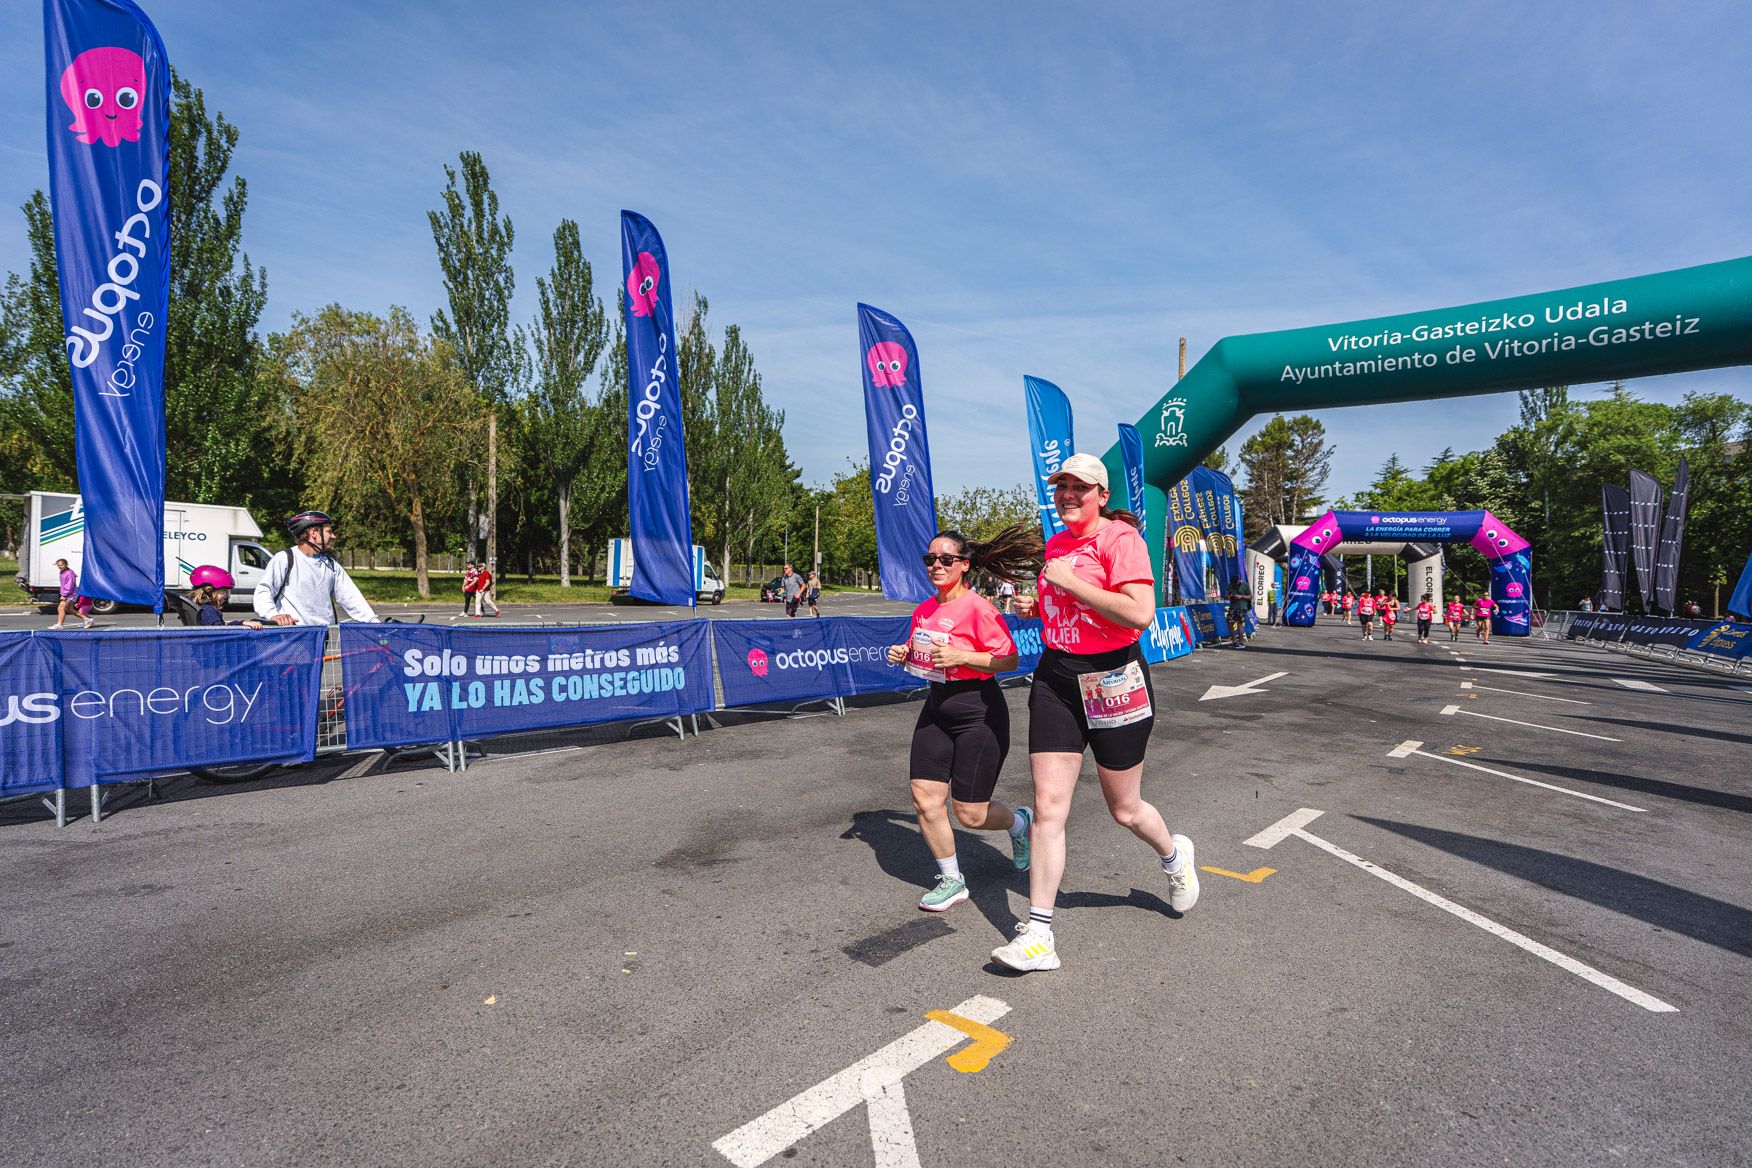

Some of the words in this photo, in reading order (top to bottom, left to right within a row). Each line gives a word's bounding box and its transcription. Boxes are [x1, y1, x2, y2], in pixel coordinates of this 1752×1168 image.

[1328, 311, 1535, 351] Vitoria-Gasteizko
[1545, 297, 1627, 324] Udala
[1280, 351, 1437, 385] Ayuntamiento
[1445, 345, 1476, 365] de
[1484, 315, 1700, 361] Vitoria-Gasteiz
[1382, 516, 1417, 525] octopus
[1417, 516, 1447, 526] energy
[1257, 565, 1265, 596] CORREO
[1425, 566, 1432, 576] EL
[1257, 597, 1263, 606] EL
[403, 648, 467, 677] Solo
[475, 652, 540, 676] unos
[547, 647, 639, 672] metros
[636, 641, 680, 667] más
[775, 648, 848, 671] octopus
[849, 646, 899, 668] ener
[913, 650, 930, 662] 016
[70, 682, 263, 725] energy
[403, 682, 442, 712] YA
[451, 680, 486, 710] LO
[493, 677, 545, 707] HAS
[551, 667, 685, 702] CONSEGUIDO
[1105, 693, 1130, 707] 016
